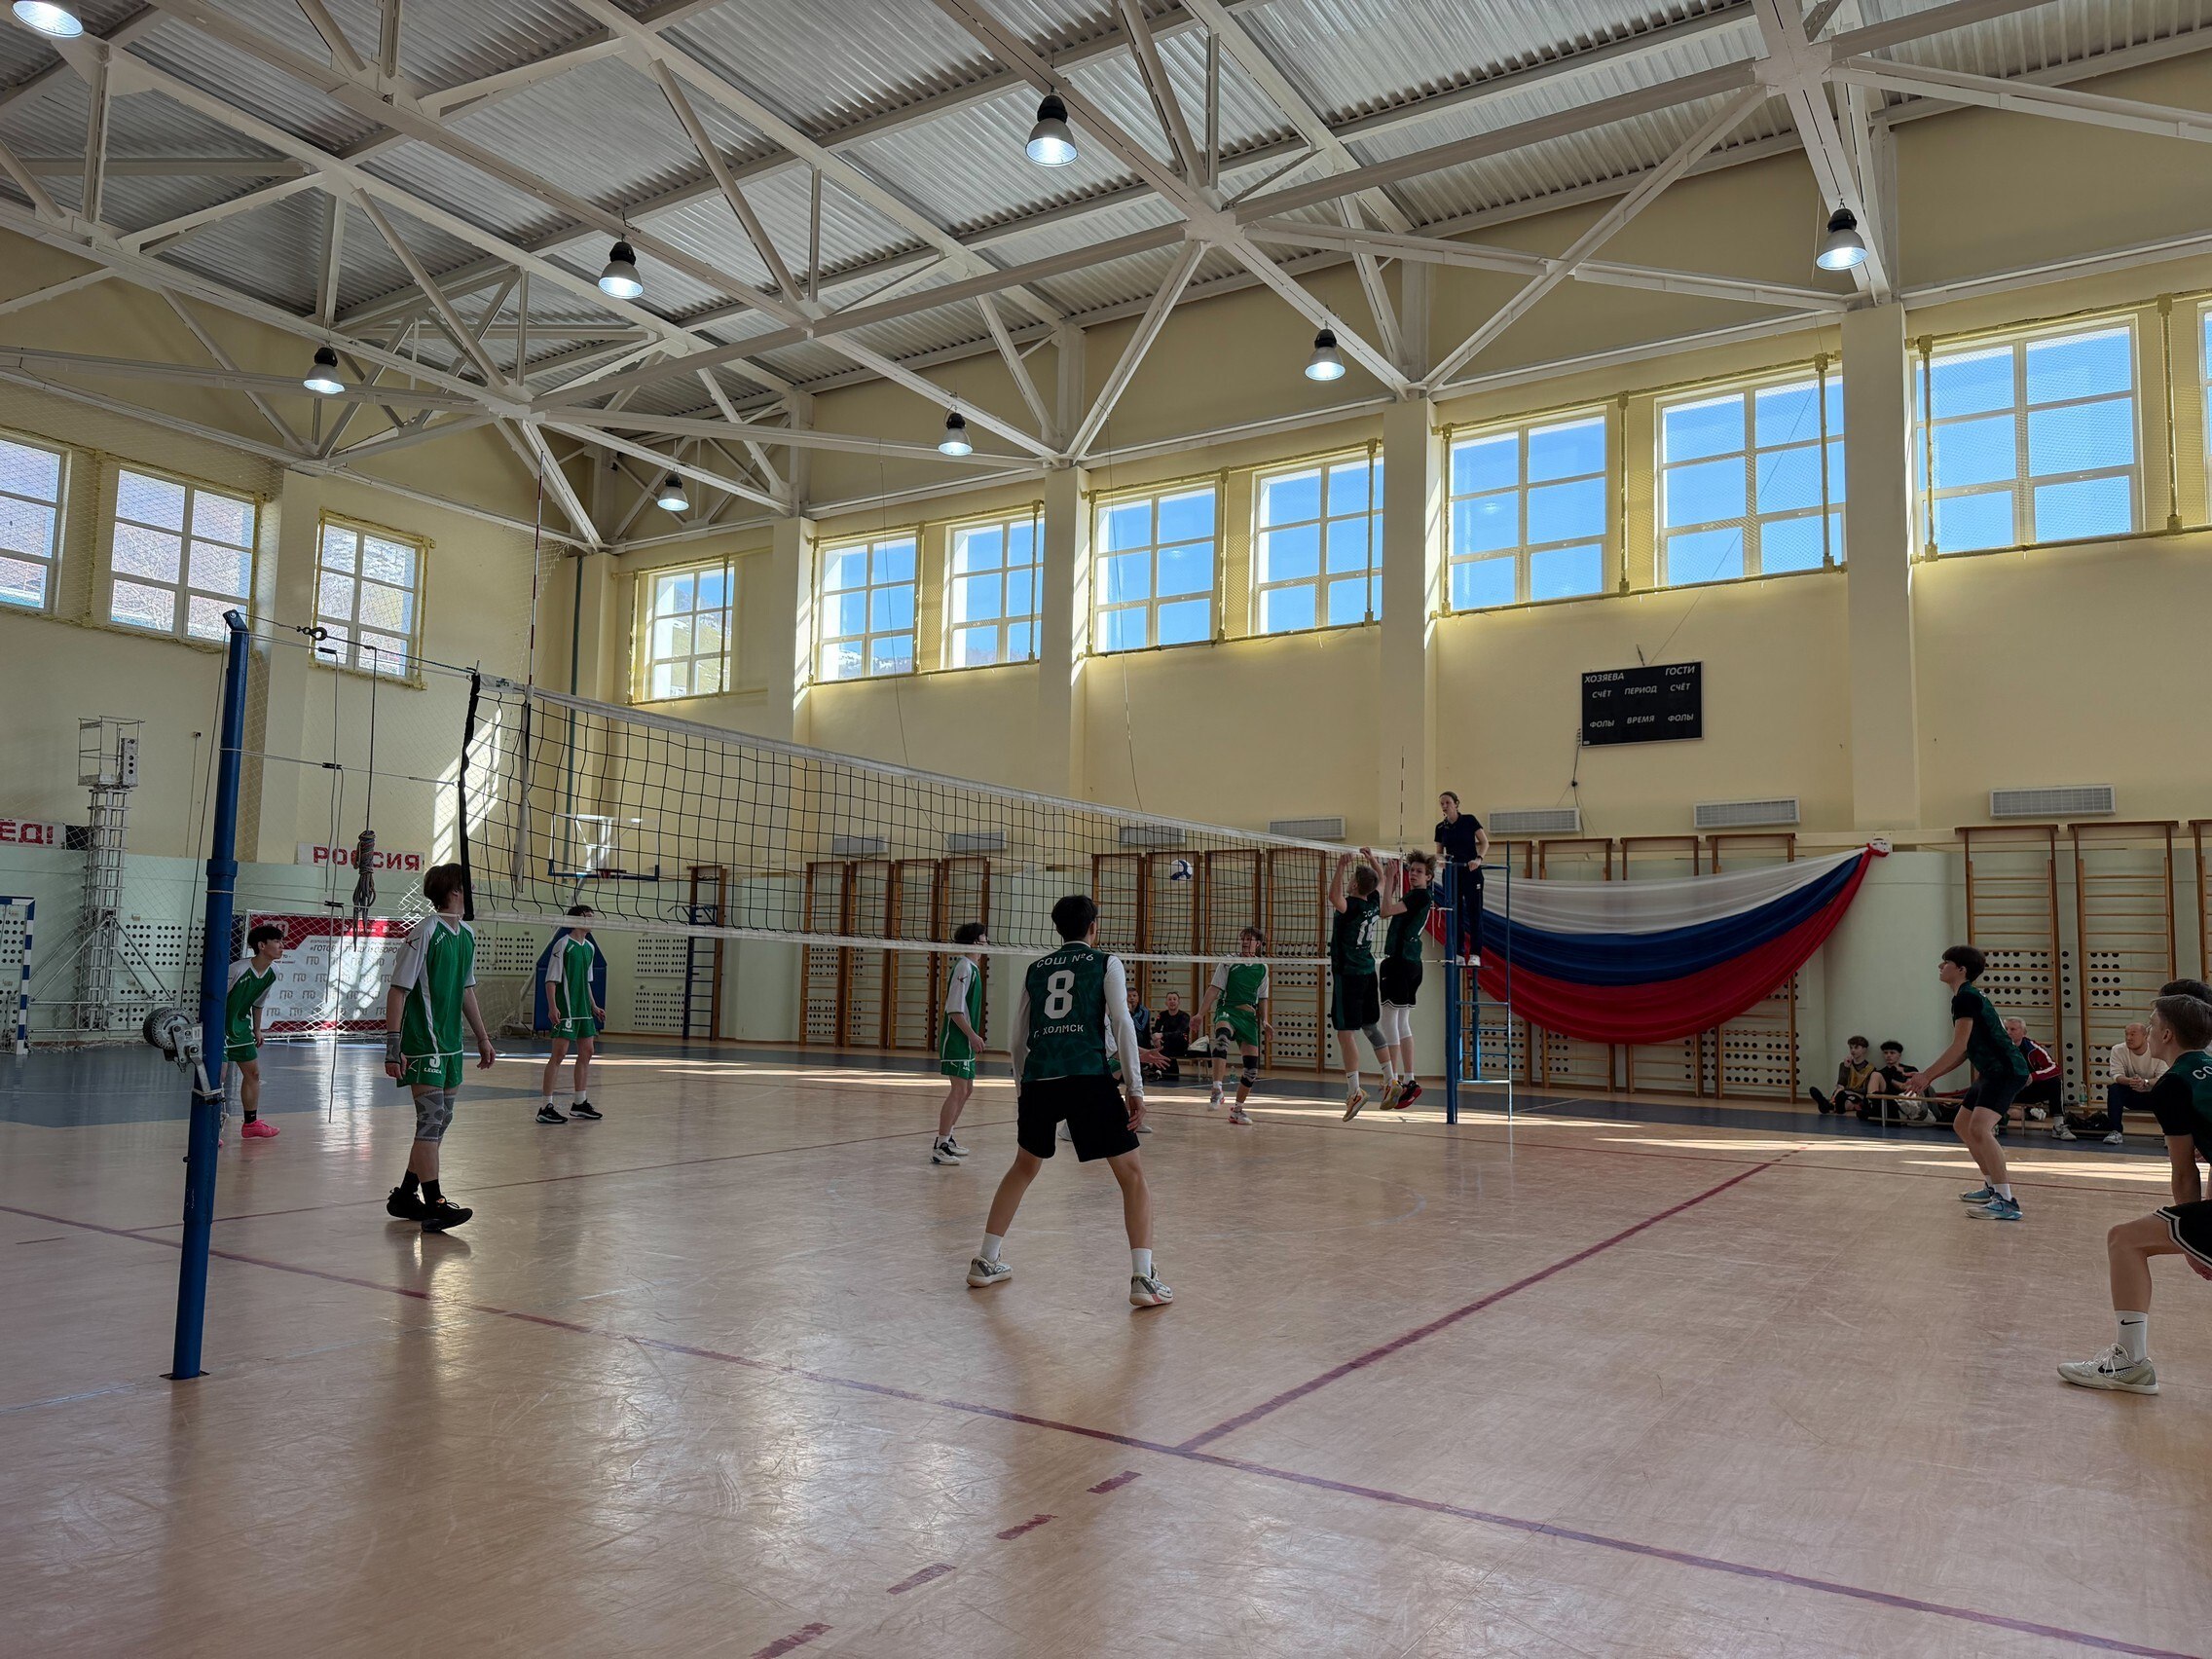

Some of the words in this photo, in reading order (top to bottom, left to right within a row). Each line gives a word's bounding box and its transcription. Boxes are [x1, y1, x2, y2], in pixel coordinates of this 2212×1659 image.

[1665, 666, 1695, 676] ГОСТИ
[1584, 673, 1624, 683] ХОЗЯЕВА
[1592, 689, 1612, 698] СЧЁТ
[1624, 685, 1657, 695] ПЕРИОД
[1670, 682, 1690, 691] СЧЁТ
[1589, 719, 1614, 728] ФОЛЫ
[1627, 715, 1655, 724] ВРЕМЯ
[1037, 956, 1067, 969] СОШ
[1071, 953, 1094, 963] №6
[1044, 969, 1075, 1019] 8
[1043, 1024, 1084, 1035] ХОЛМСК
